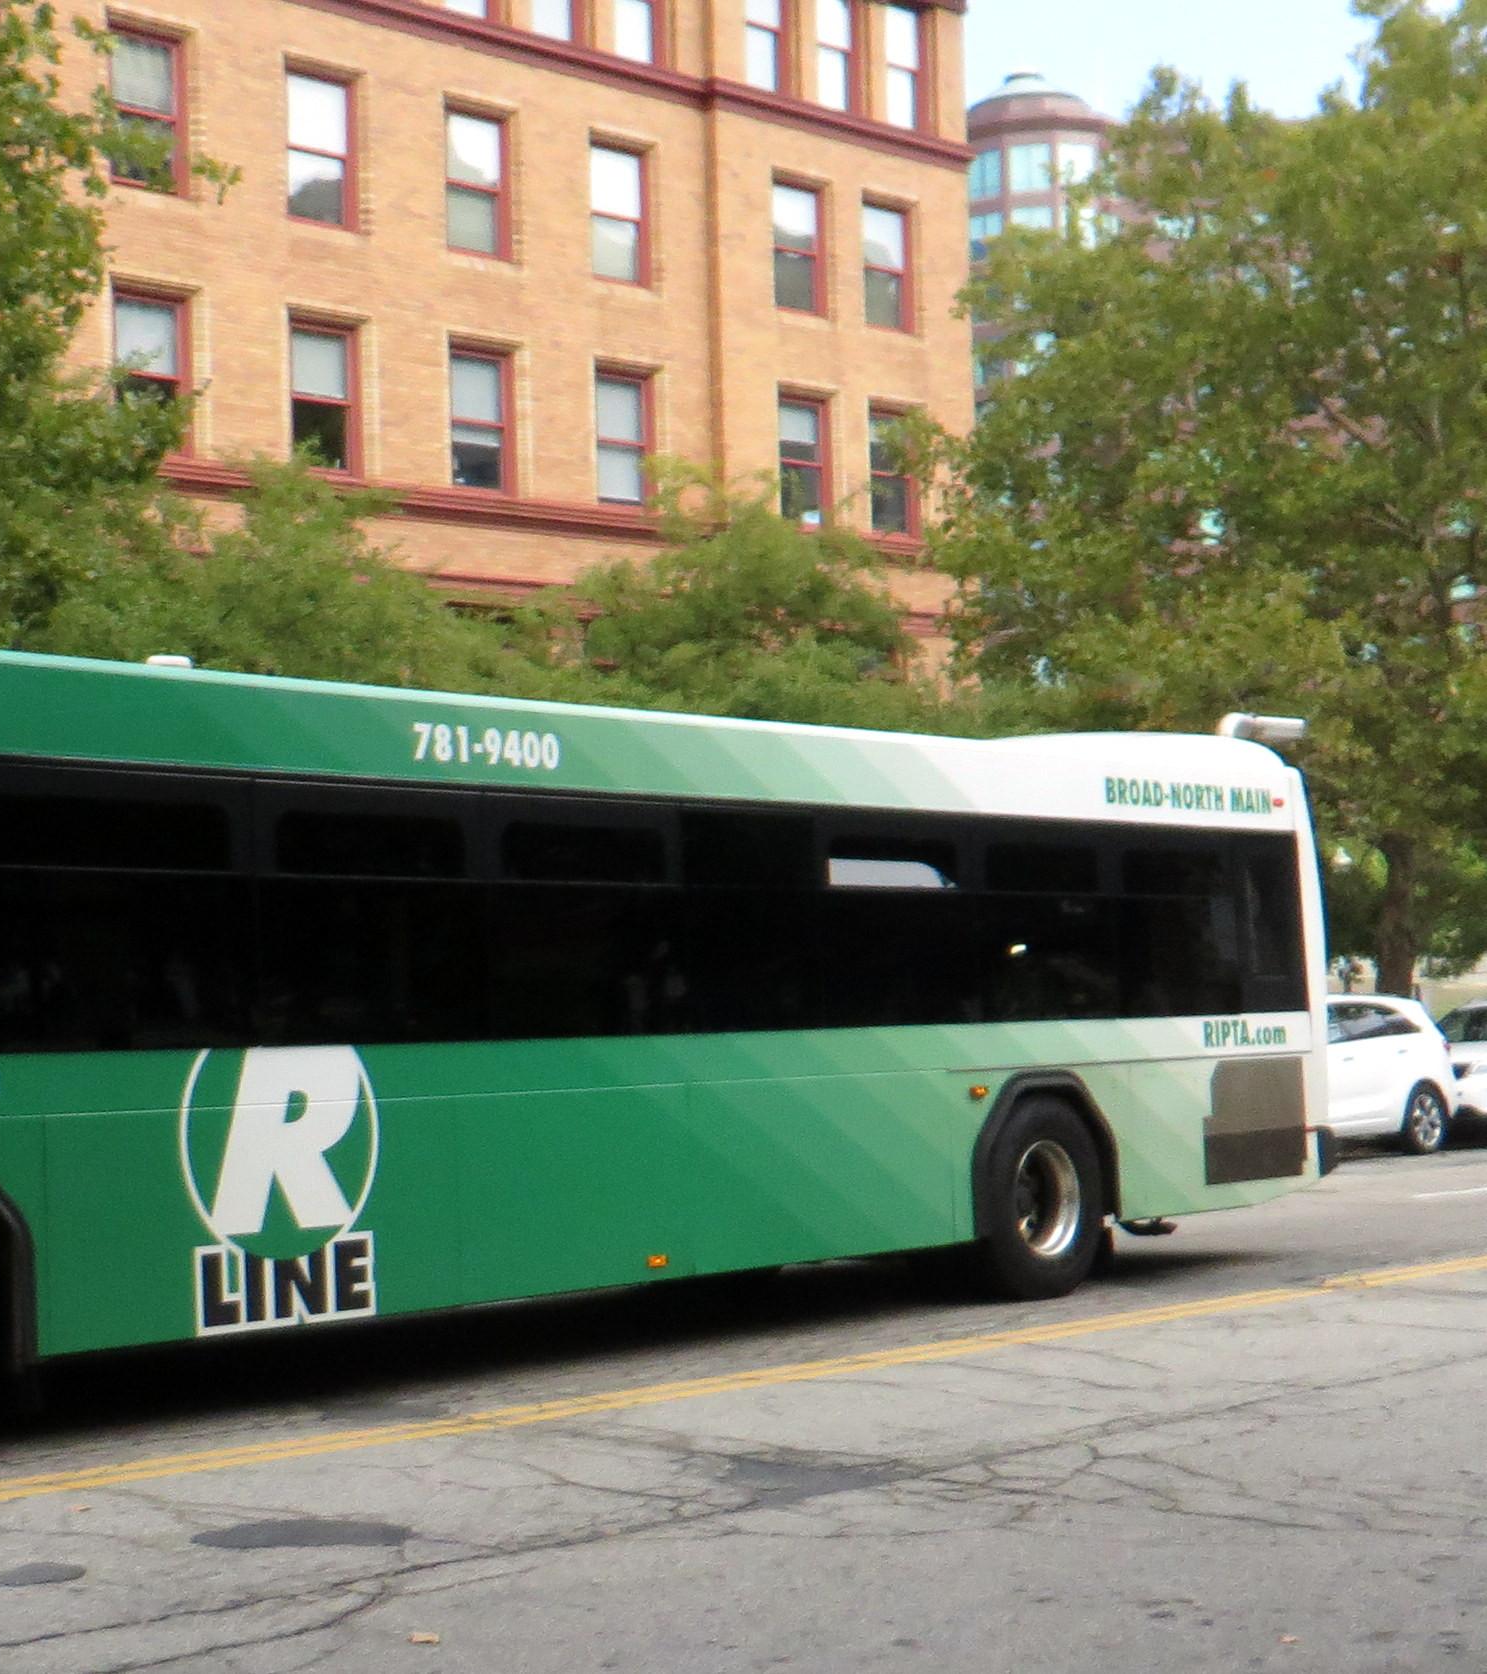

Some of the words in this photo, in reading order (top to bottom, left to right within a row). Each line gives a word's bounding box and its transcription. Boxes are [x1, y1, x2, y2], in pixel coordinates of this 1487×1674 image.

[413, 722, 560, 769] 781-9400
[1105, 777, 1224, 811] BROAD-NORTH
[1230, 787, 1271, 814] MAIN
[1203, 1020, 1287, 1047] RIPTA.com
[211, 1046, 362, 1241] R
[195, 1232, 375, 1334] LINE
